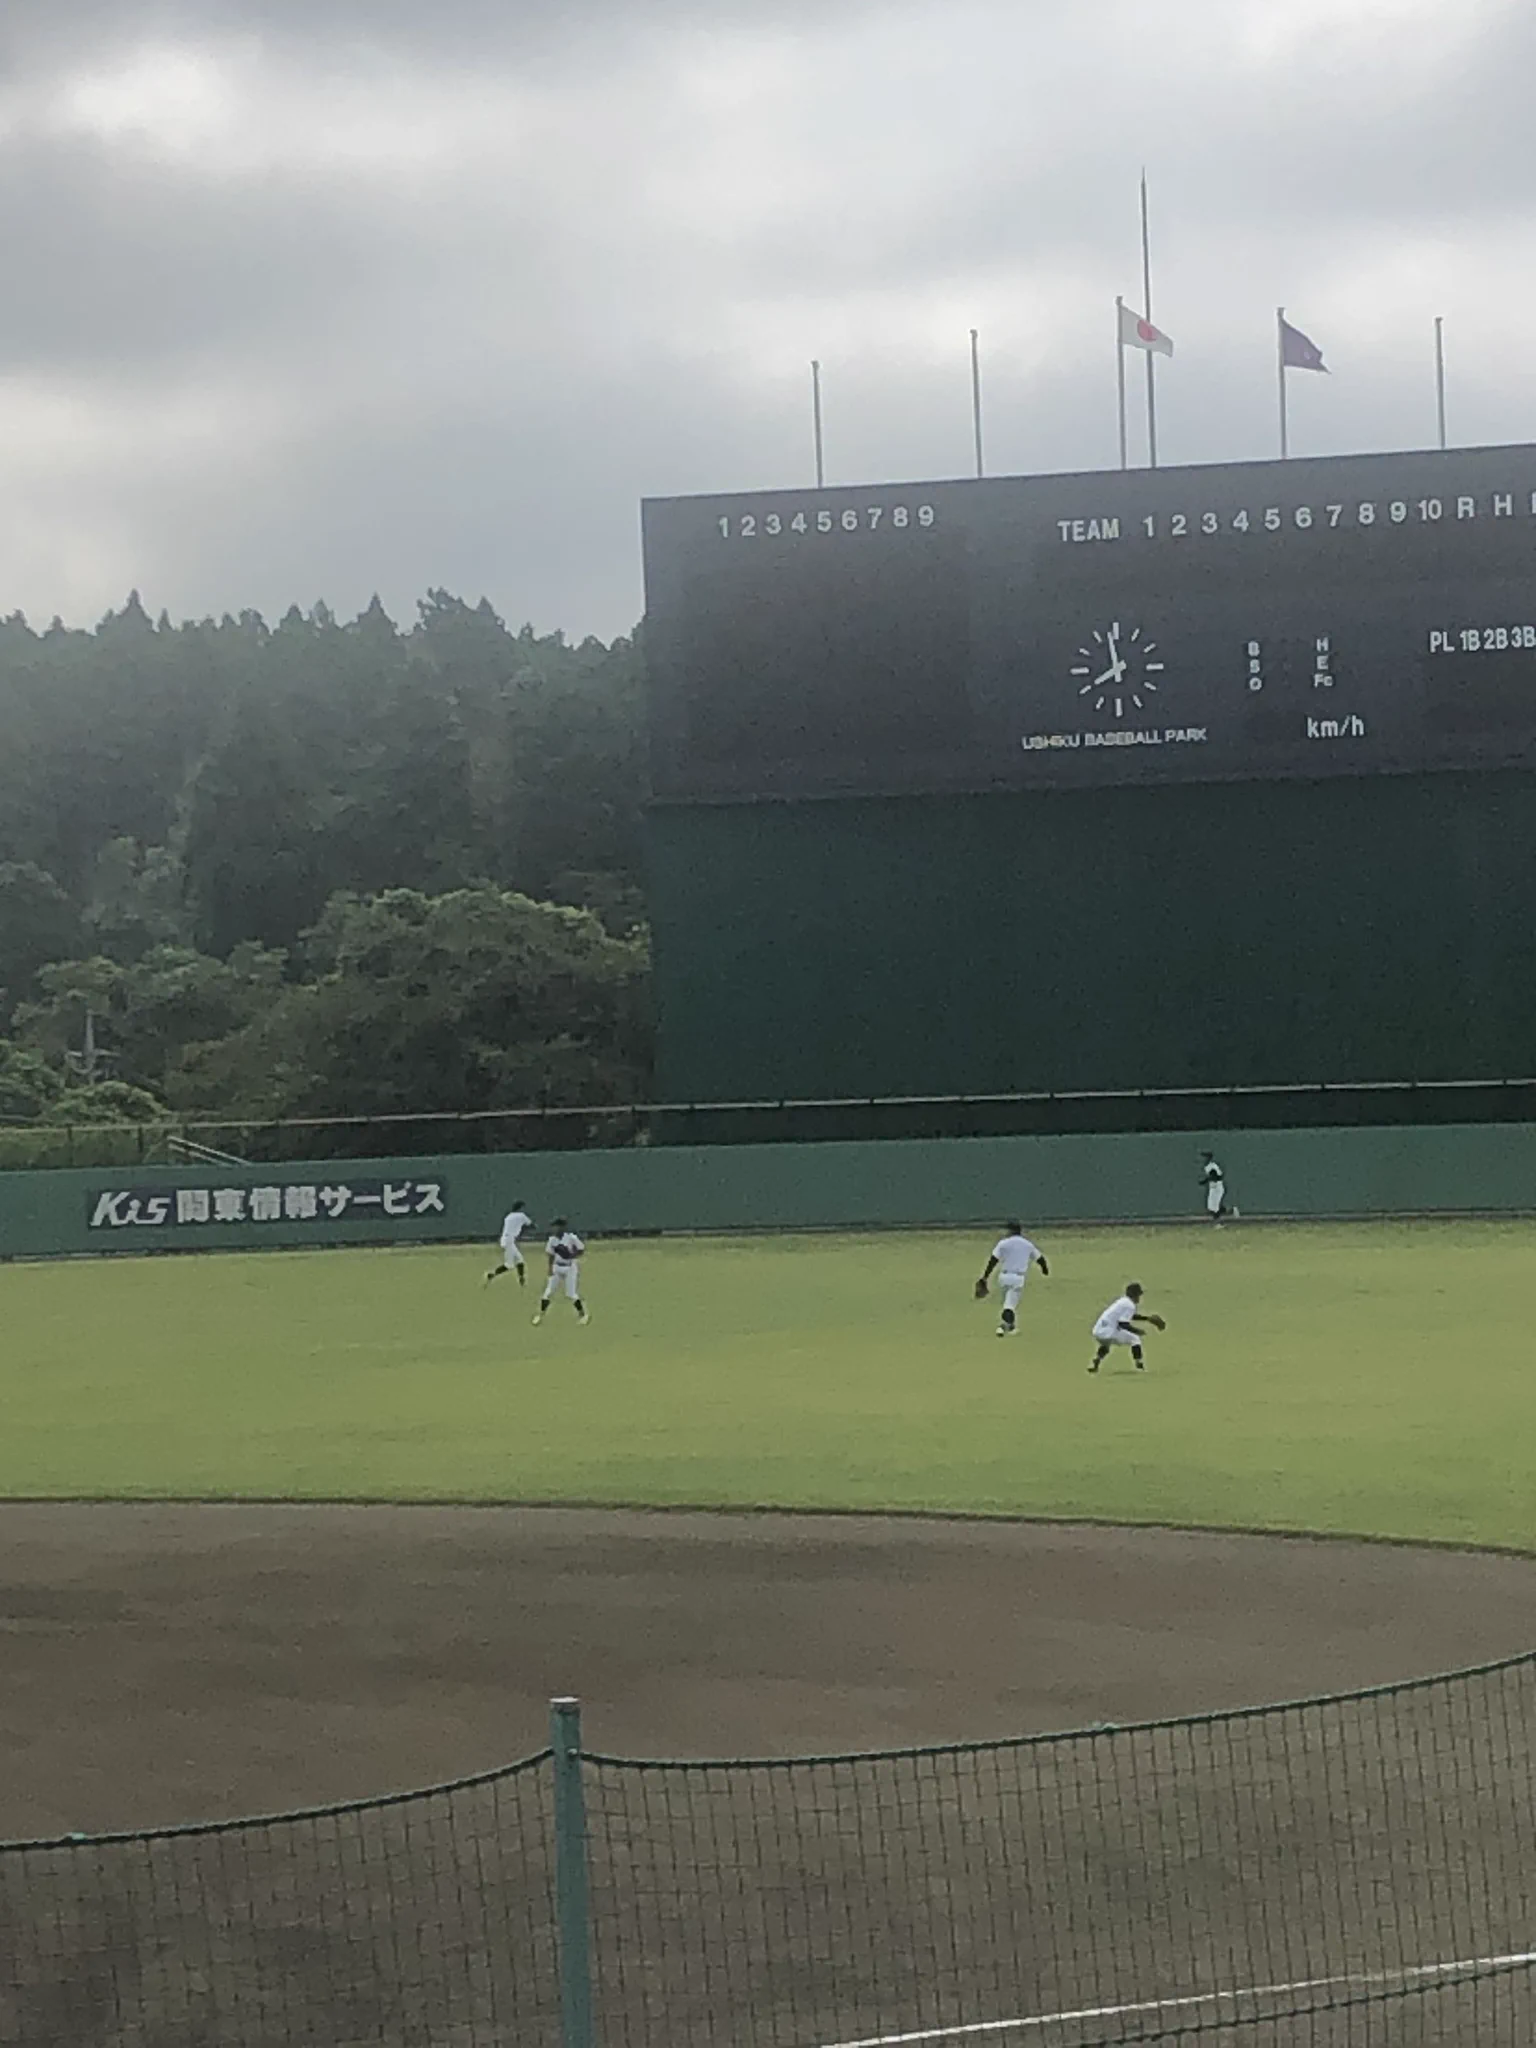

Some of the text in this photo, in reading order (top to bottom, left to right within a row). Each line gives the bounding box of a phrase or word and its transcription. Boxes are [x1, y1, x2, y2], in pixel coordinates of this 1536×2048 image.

[740, 514, 756, 537] 2
[765, 513, 782, 535] 3
[791, 512, 808, 533] 4
[816, 510, 832, 532] 5
[841, 509, 858, 531] 6
[867, 507, 882, 529] 7
[893, 506, 908, 527] 8
[918, 505, 934, 527] 9
[1057, 518, 1119, 542] TEAM
[1142, 515, 1154, 538] 1
[1171, 514, 1187, 536] 2
[1201, 512, 1218, 534] 3
[1233, 510, 1249, 532] 4
[1264, 507, 1281, 531] 5
[1295, 506, 1312, 528] 6
[1326, 504, 1343, 527] 7
[1358, 502, 1375, 525] 8
[1389, 501, 1407, 523] 9
[1418, 498, 1442, 521] 10
[1457, 496, 1475, 519] R
[1493, 493, 1513, 517] H
[1429, 625, 1536, 653] PL 1B 2B 3B
[1316, 655, 1329, 670] E
[1084, 729, 1163, 747] BASEBALL
[1164, 727, 1207, 743] PARK
[1306, 715, 1365, 738] km/h
[176, 1181, 445, 1223] 関東情報サービス
